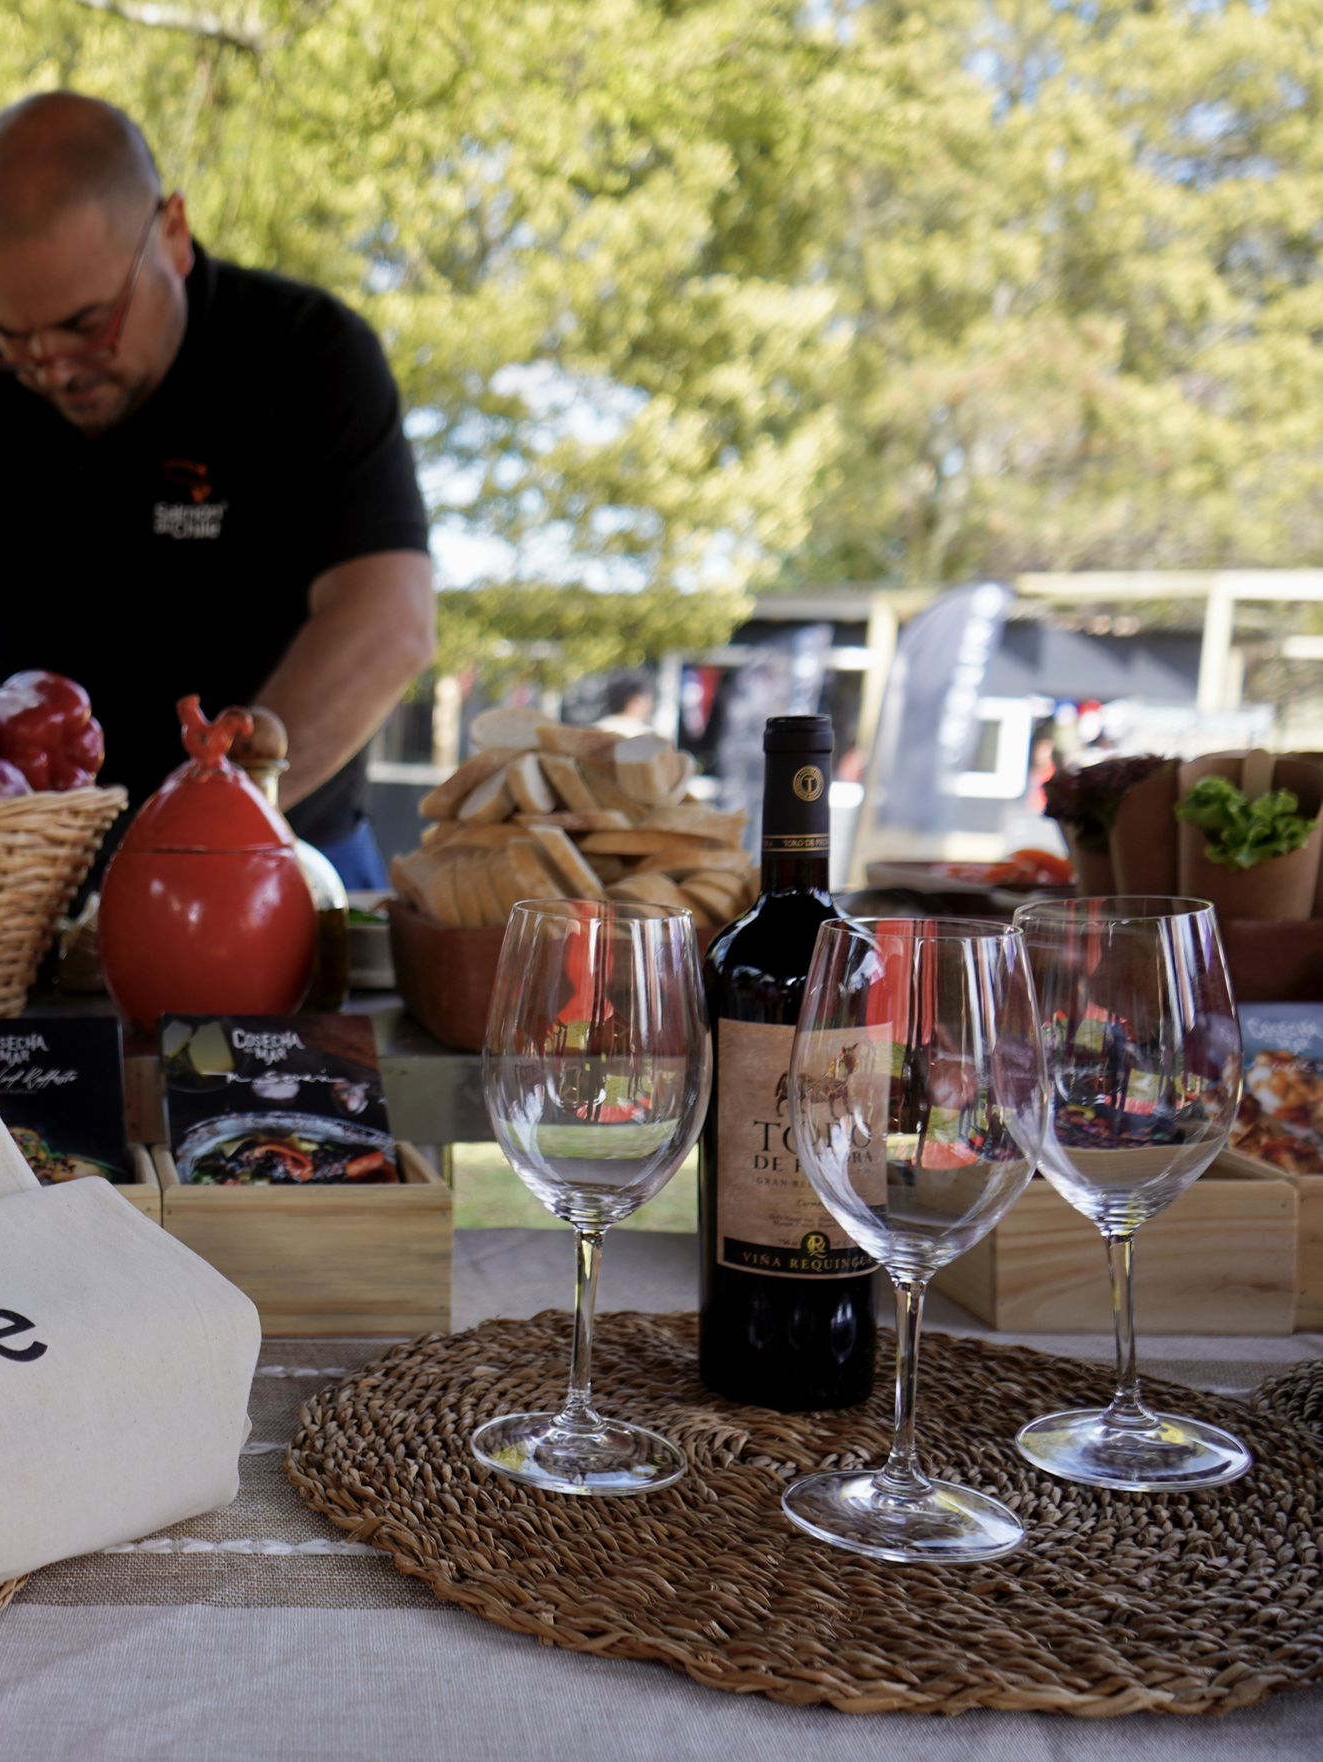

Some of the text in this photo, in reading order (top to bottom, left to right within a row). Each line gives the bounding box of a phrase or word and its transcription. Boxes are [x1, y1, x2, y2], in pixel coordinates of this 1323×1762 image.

[232, 1027, 306, 1050] COSECHA
[254, 1047, 287, 1066] MAR
[754, 1155, 783, 1173] DE
[756, 1177, 787, 1187] GRAN
[742, 1252, 781, 1267] VIÑA
